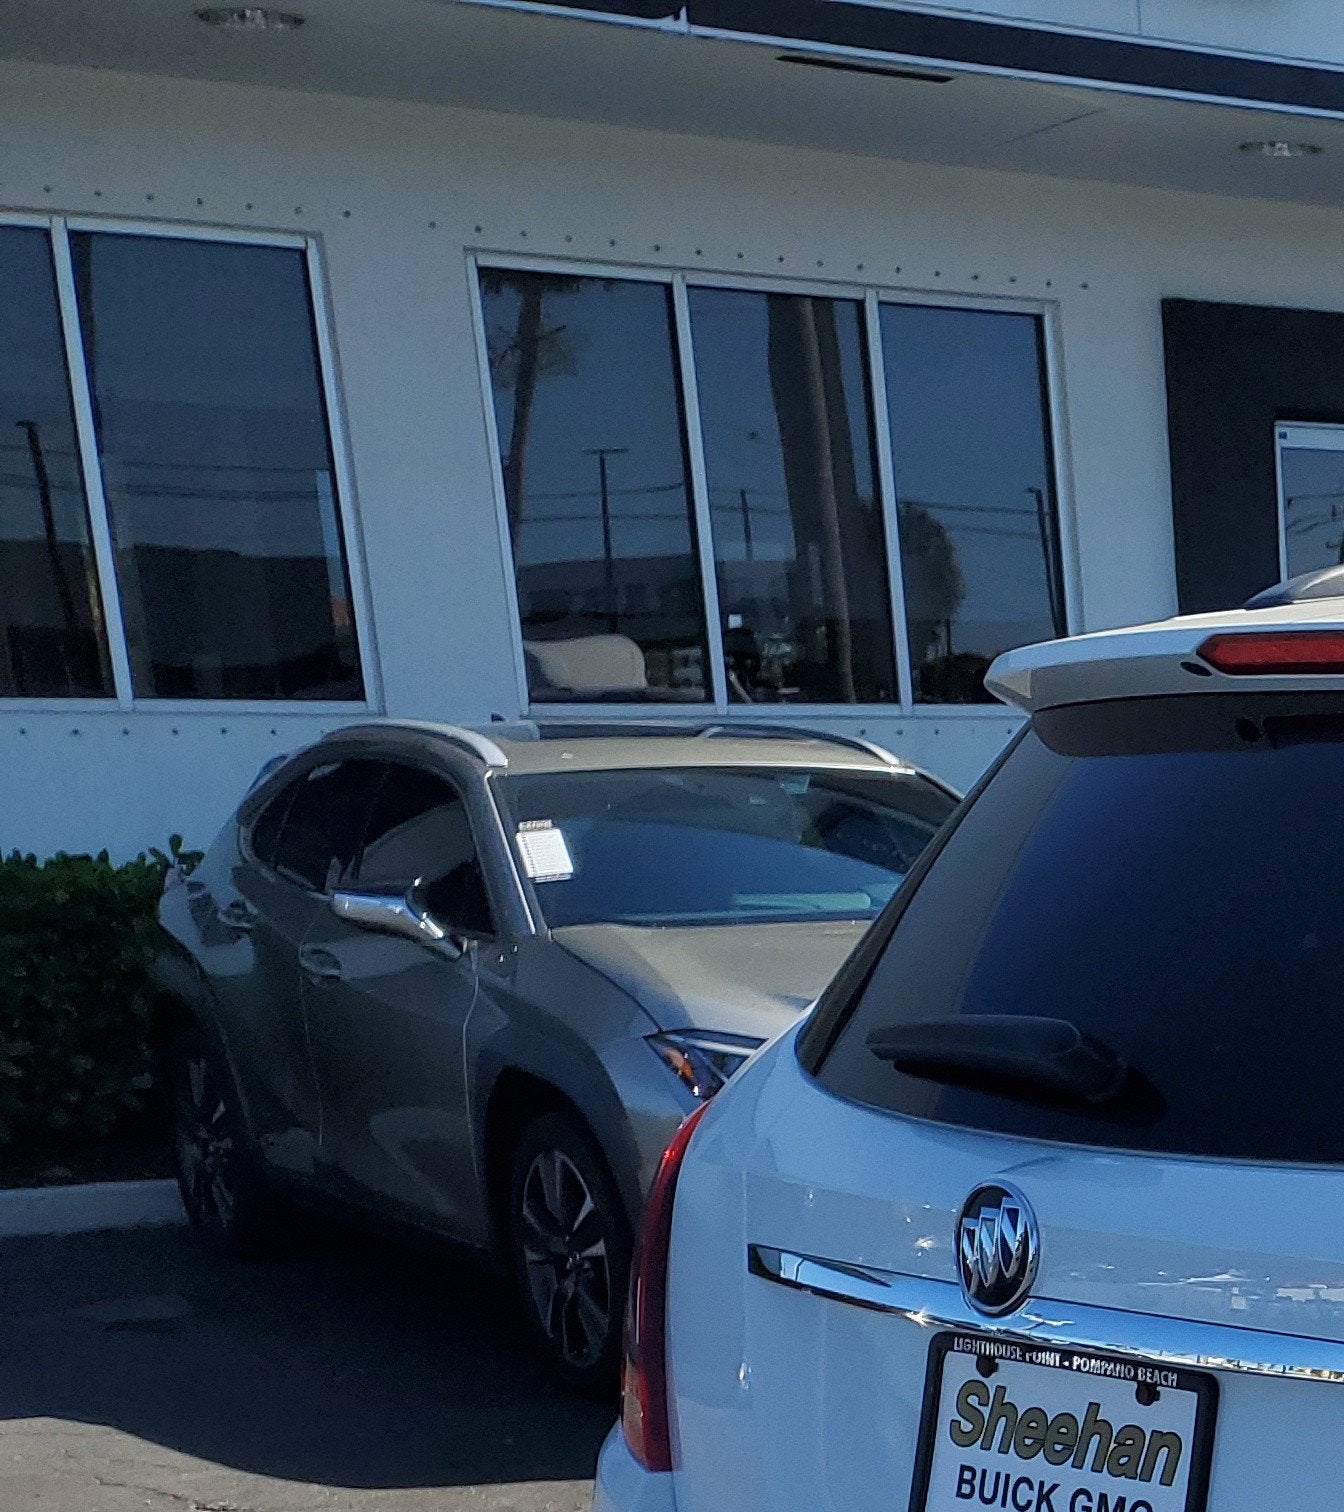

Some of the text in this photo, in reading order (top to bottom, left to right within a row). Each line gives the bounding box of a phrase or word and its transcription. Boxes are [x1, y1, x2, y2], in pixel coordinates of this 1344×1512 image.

[953, 1336, 1023, 1361] LIGHTHOUSE
[1072, 1355, 1134, 1379] POMPANO
[1137, 1367, 1178, 1388] BEACH
[950, 1379, 1182, 1487] Sheehan
